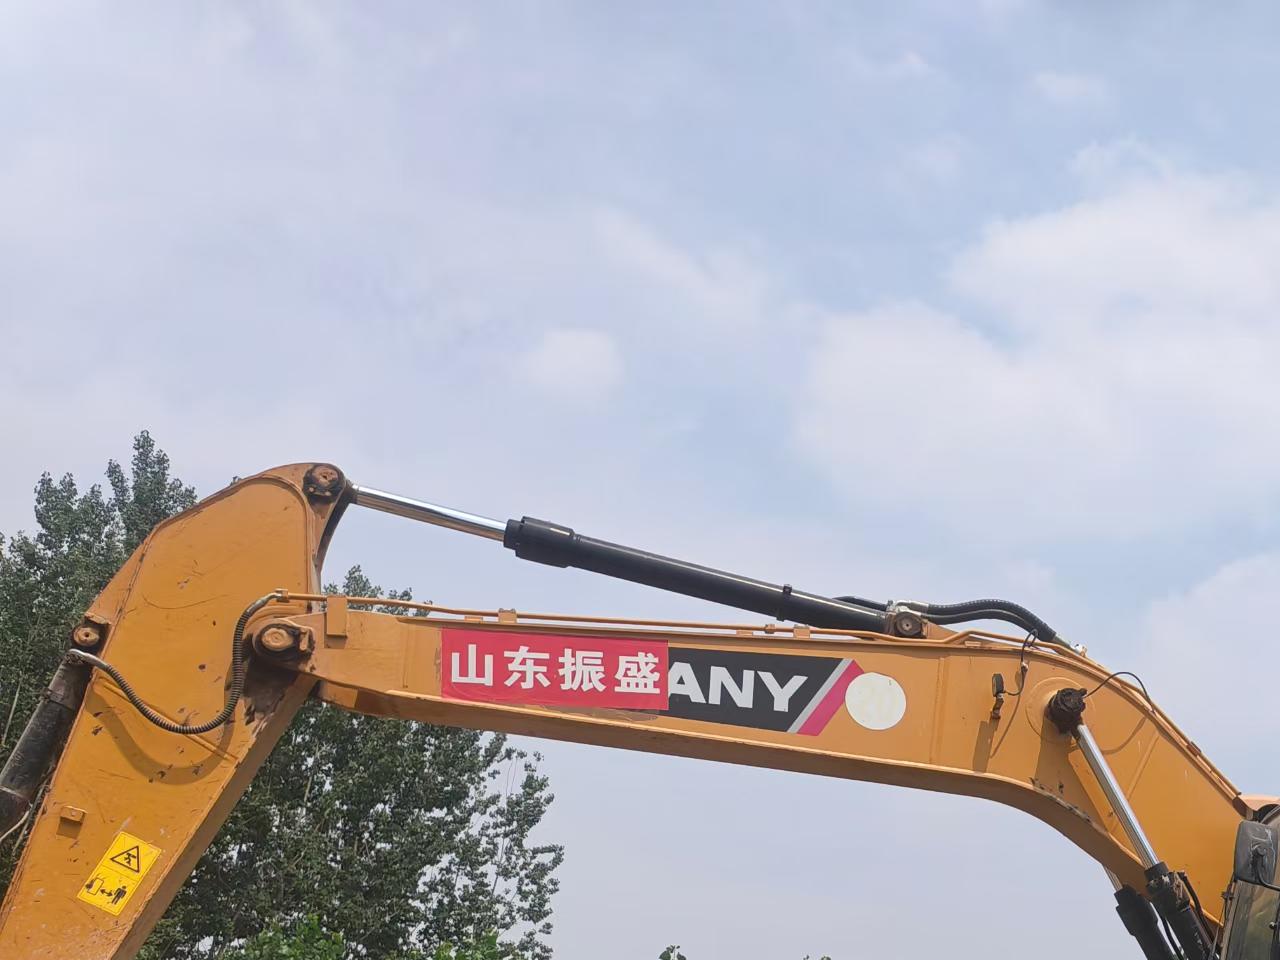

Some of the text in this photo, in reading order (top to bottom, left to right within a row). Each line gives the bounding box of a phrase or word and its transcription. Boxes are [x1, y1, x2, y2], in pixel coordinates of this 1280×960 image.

[450, 643, 662, 695] 山东振盛
[668, 661, 808, 712] ANY
